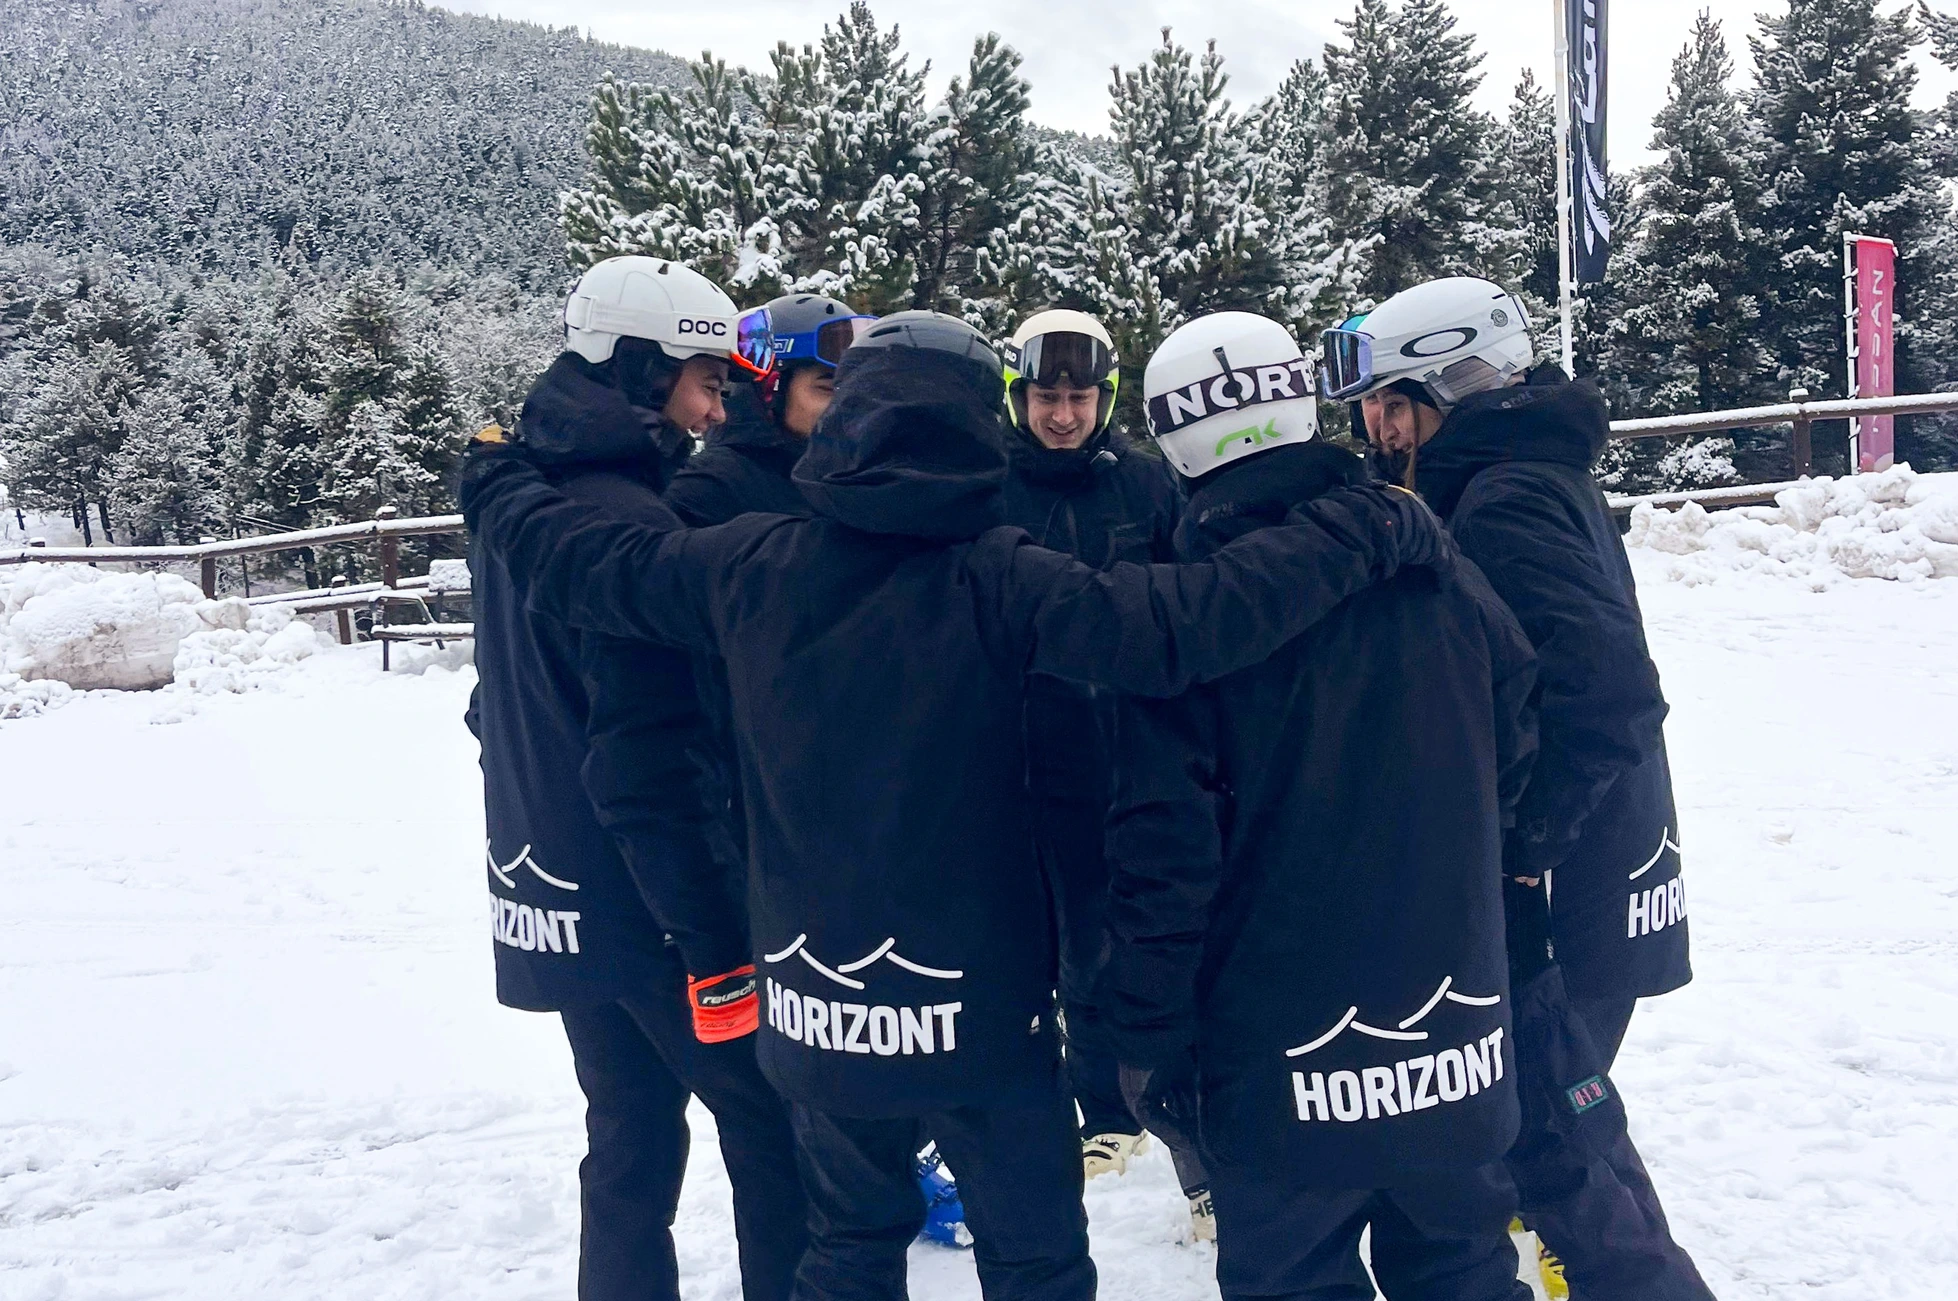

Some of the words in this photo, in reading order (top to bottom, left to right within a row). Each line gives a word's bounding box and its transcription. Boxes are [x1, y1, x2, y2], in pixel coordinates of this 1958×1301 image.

[678, 318, 727, 336] POC
[766, 976, 962, 1056] HORIZONT
[1292, 1026, 1504, 1122] HORIZONT
